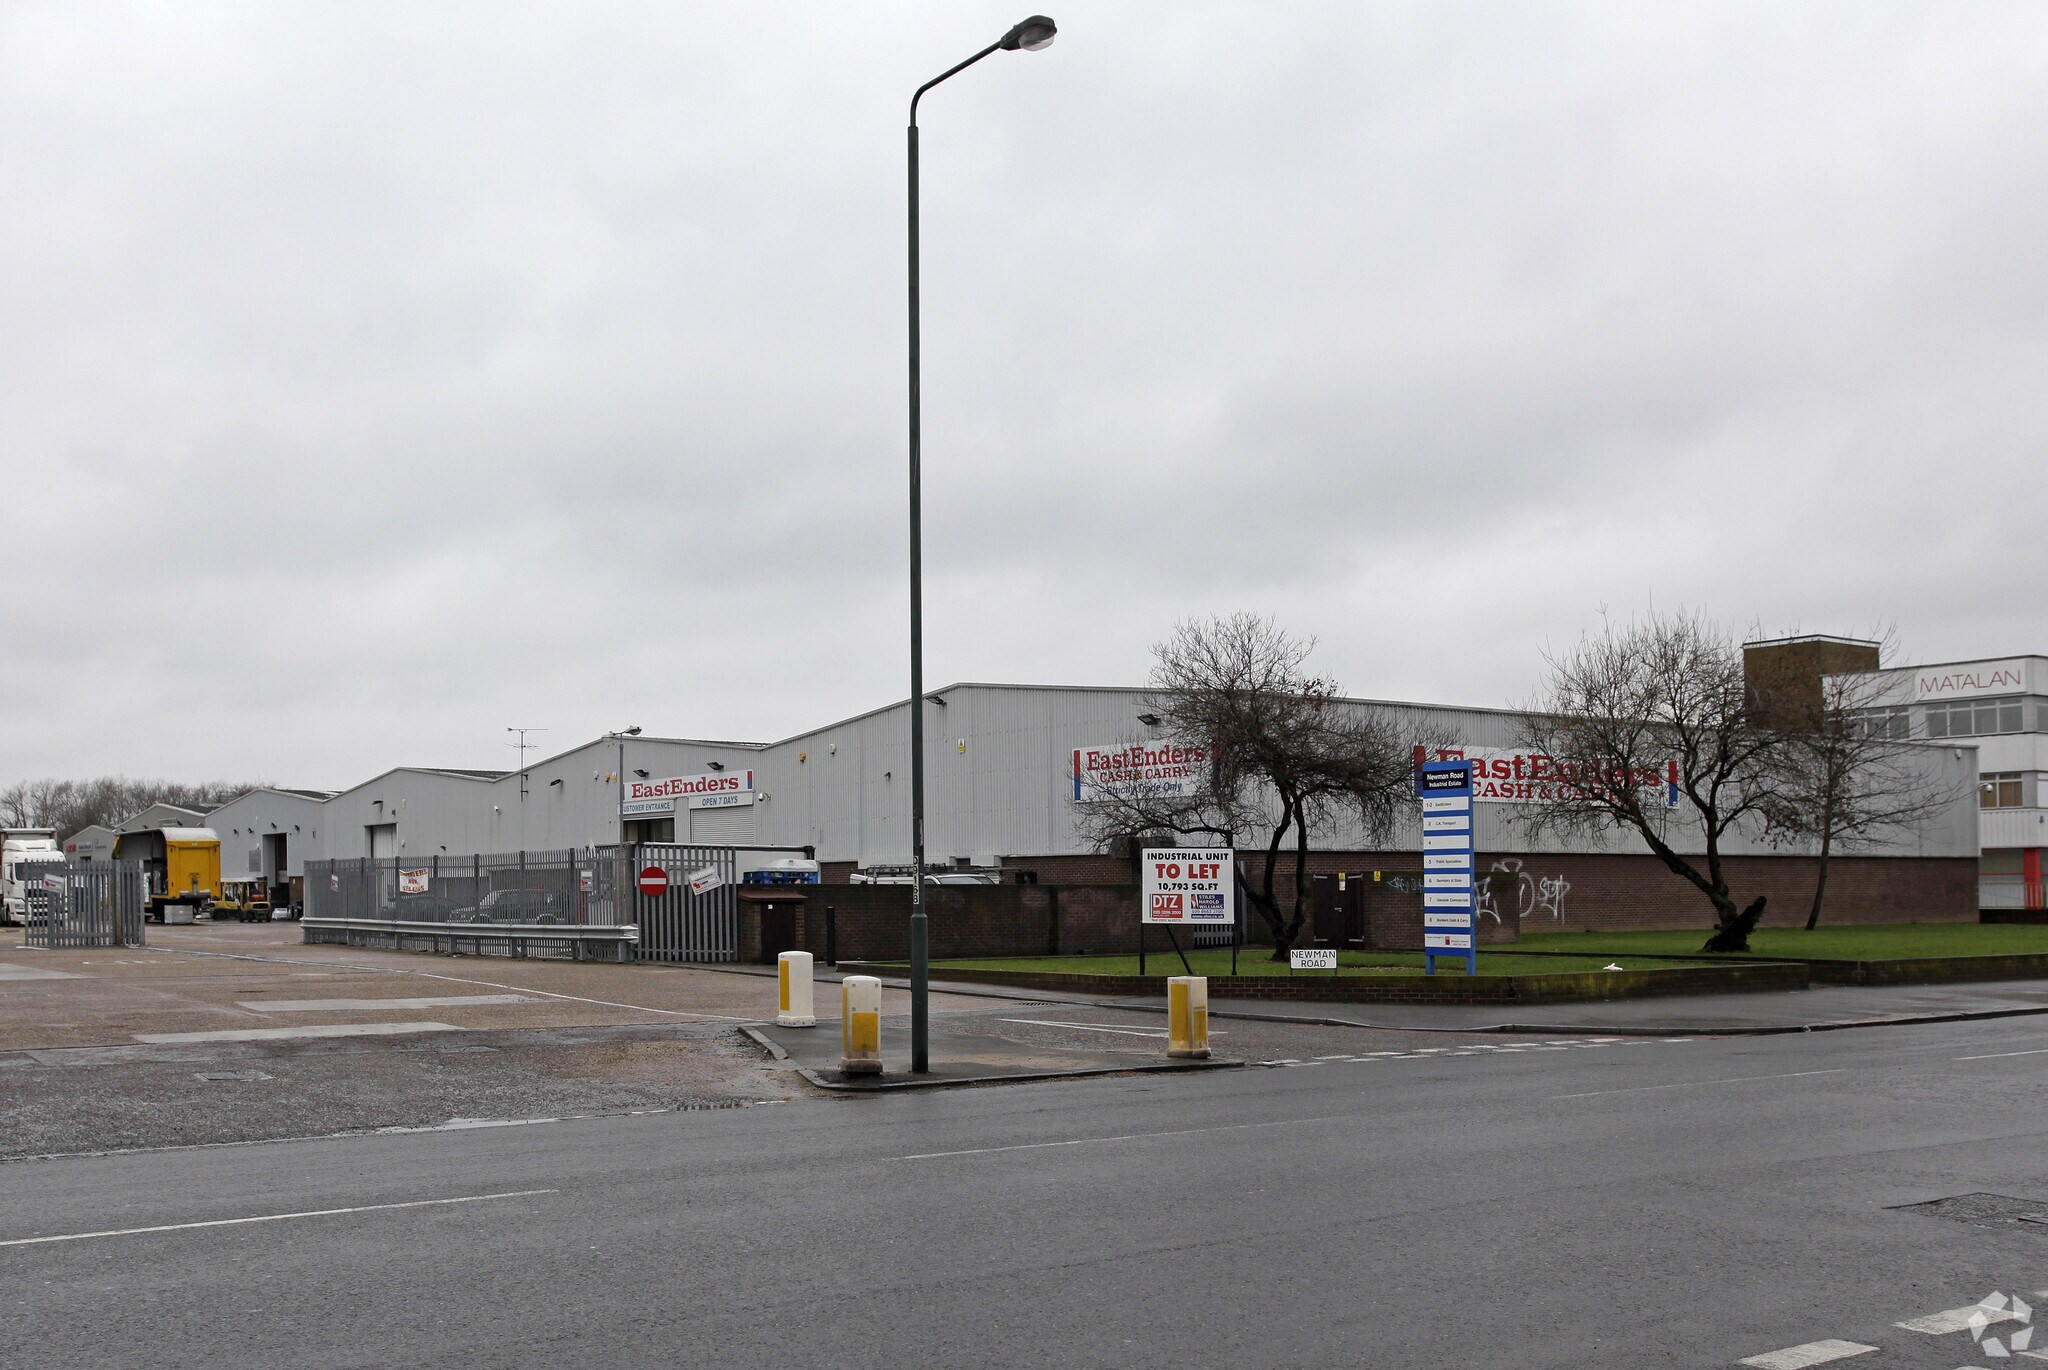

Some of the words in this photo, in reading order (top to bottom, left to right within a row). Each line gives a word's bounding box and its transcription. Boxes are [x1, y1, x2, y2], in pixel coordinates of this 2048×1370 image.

[1920, 669, 2021, 693] MATALAN
[1086, 744, 1206, 771] EastEnders
[1100, 769, 1132, 783] CASH
[1145, 766, 1191, 780] CARRY
[1449, 771, 1464, 779] Road
[631, 776, 739, 798] EastEnders
[1107, 783, 1136, 796] Strictly
[1138, 782, 1161, 793] Trade
[1163, 781, 1183, 793] Only
[623, 803, 645, 813] USTOMER
[645, 802, 671, 811] ENTRANCE
[702, 797, 718, 806] OPEN
[718, 797, 722, 805] 7
[723, 795, 738, 804] DAYS
[1147, 852, 1203, 860] INDUSTRIAL
[1205, 852, 1229, 860] UNIT
[1155, 863, 1181, 879] TO
[1188, 863, 1220, 879] LET
[1158, 882, 1188, 891] 10,793
[1191, 883, 1218, 891] SQ.FT
[1153, 895, 1178, 908] DTZ
